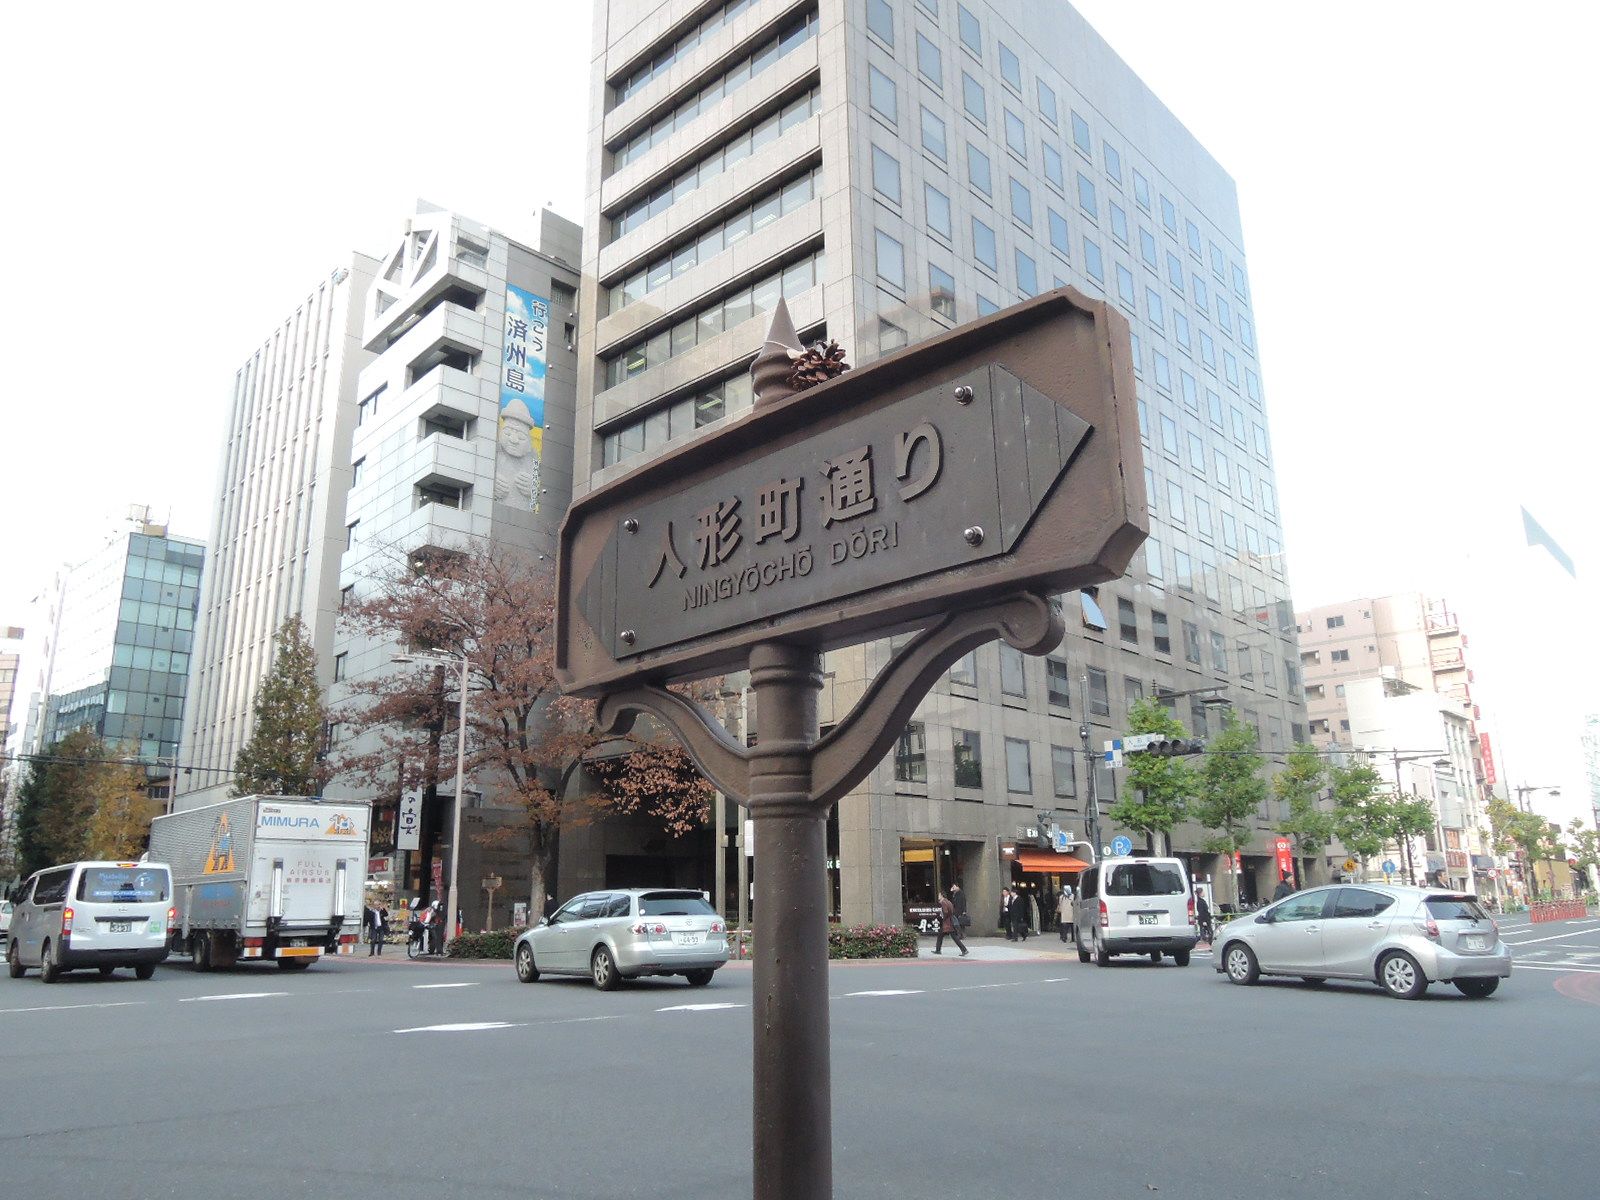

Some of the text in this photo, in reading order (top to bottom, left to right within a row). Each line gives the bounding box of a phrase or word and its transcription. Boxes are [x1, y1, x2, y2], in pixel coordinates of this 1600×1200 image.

[506, 316, 528, 393] 済州島
[532, 300, 547, 352] 行こう
[649, 422, 943, 588] 人形町通り
[683, 521, 898, 611] NINGYŌCHŌ DŌRI
[261, 816, 320, 828] MIMURA
